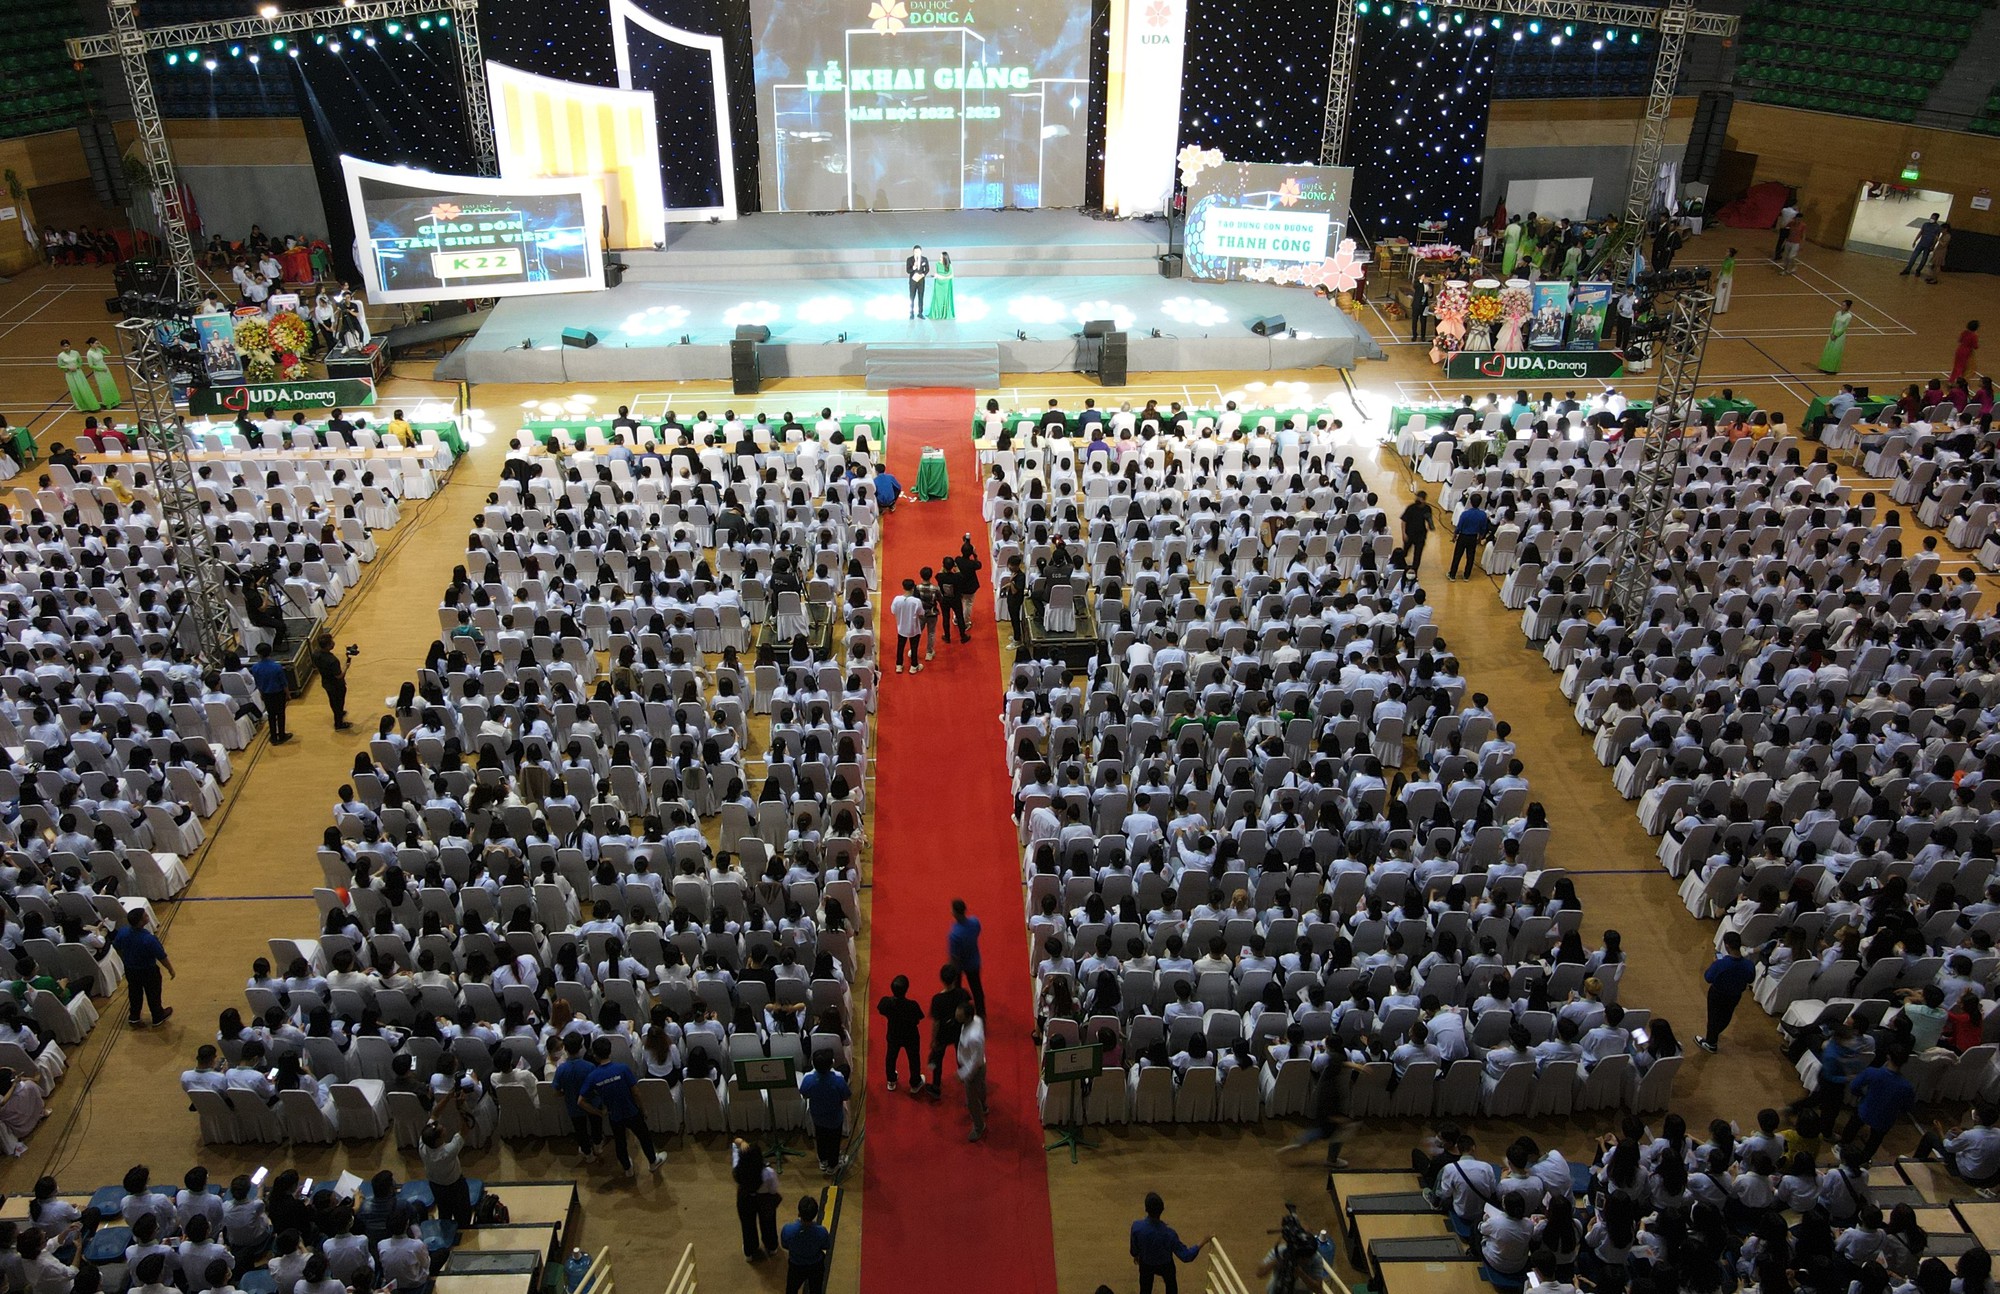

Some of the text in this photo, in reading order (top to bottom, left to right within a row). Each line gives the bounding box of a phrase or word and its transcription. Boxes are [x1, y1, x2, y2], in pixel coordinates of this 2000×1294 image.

[1141, 34, 1171, 45] UDA
[850, 67, 926, 91] KHAI
[933, 60, 1030, 90] GIẢNG
[919, 106, 955, 120] 2022
[965, 106, 1001, 119] 2023
[1263, 222, 1281, 231] CON
[444, 235, 496, 246] SINH
[1474, 357, 1480, 370] I
[1547, 359, 1588, 378] Danang
[215, 392, 222, 405] I
[293, 391, 336, 407] Danang
[1070, 1053, 1077, 1063] E
[761, 1063, 770, 1073] C
